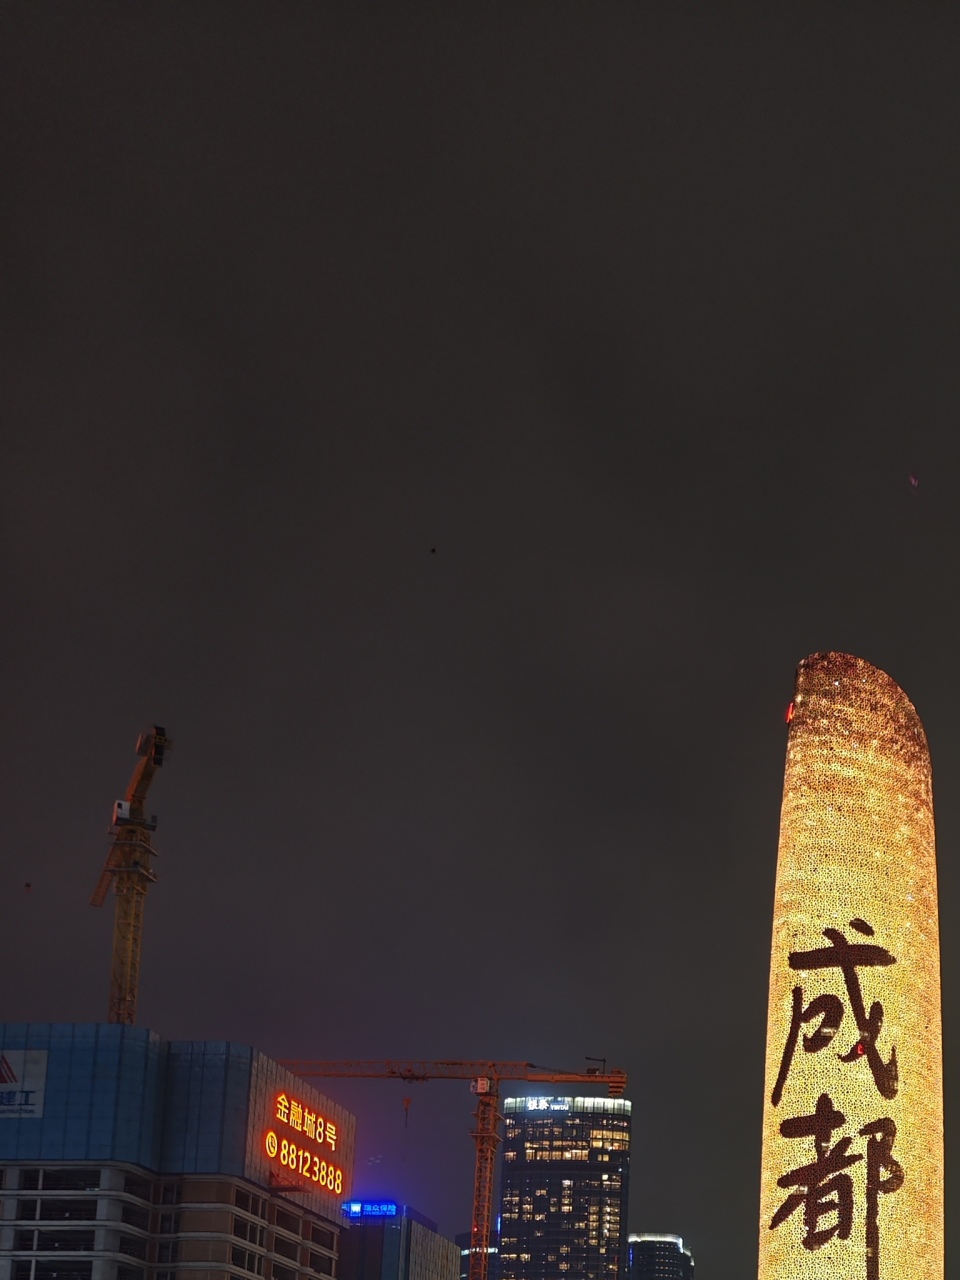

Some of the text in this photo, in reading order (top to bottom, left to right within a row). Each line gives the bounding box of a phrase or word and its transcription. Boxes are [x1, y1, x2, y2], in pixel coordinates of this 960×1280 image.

[276, 1094, 337, 1151] 金融城8号
[280, 1140, 342, 1194] 88123888
